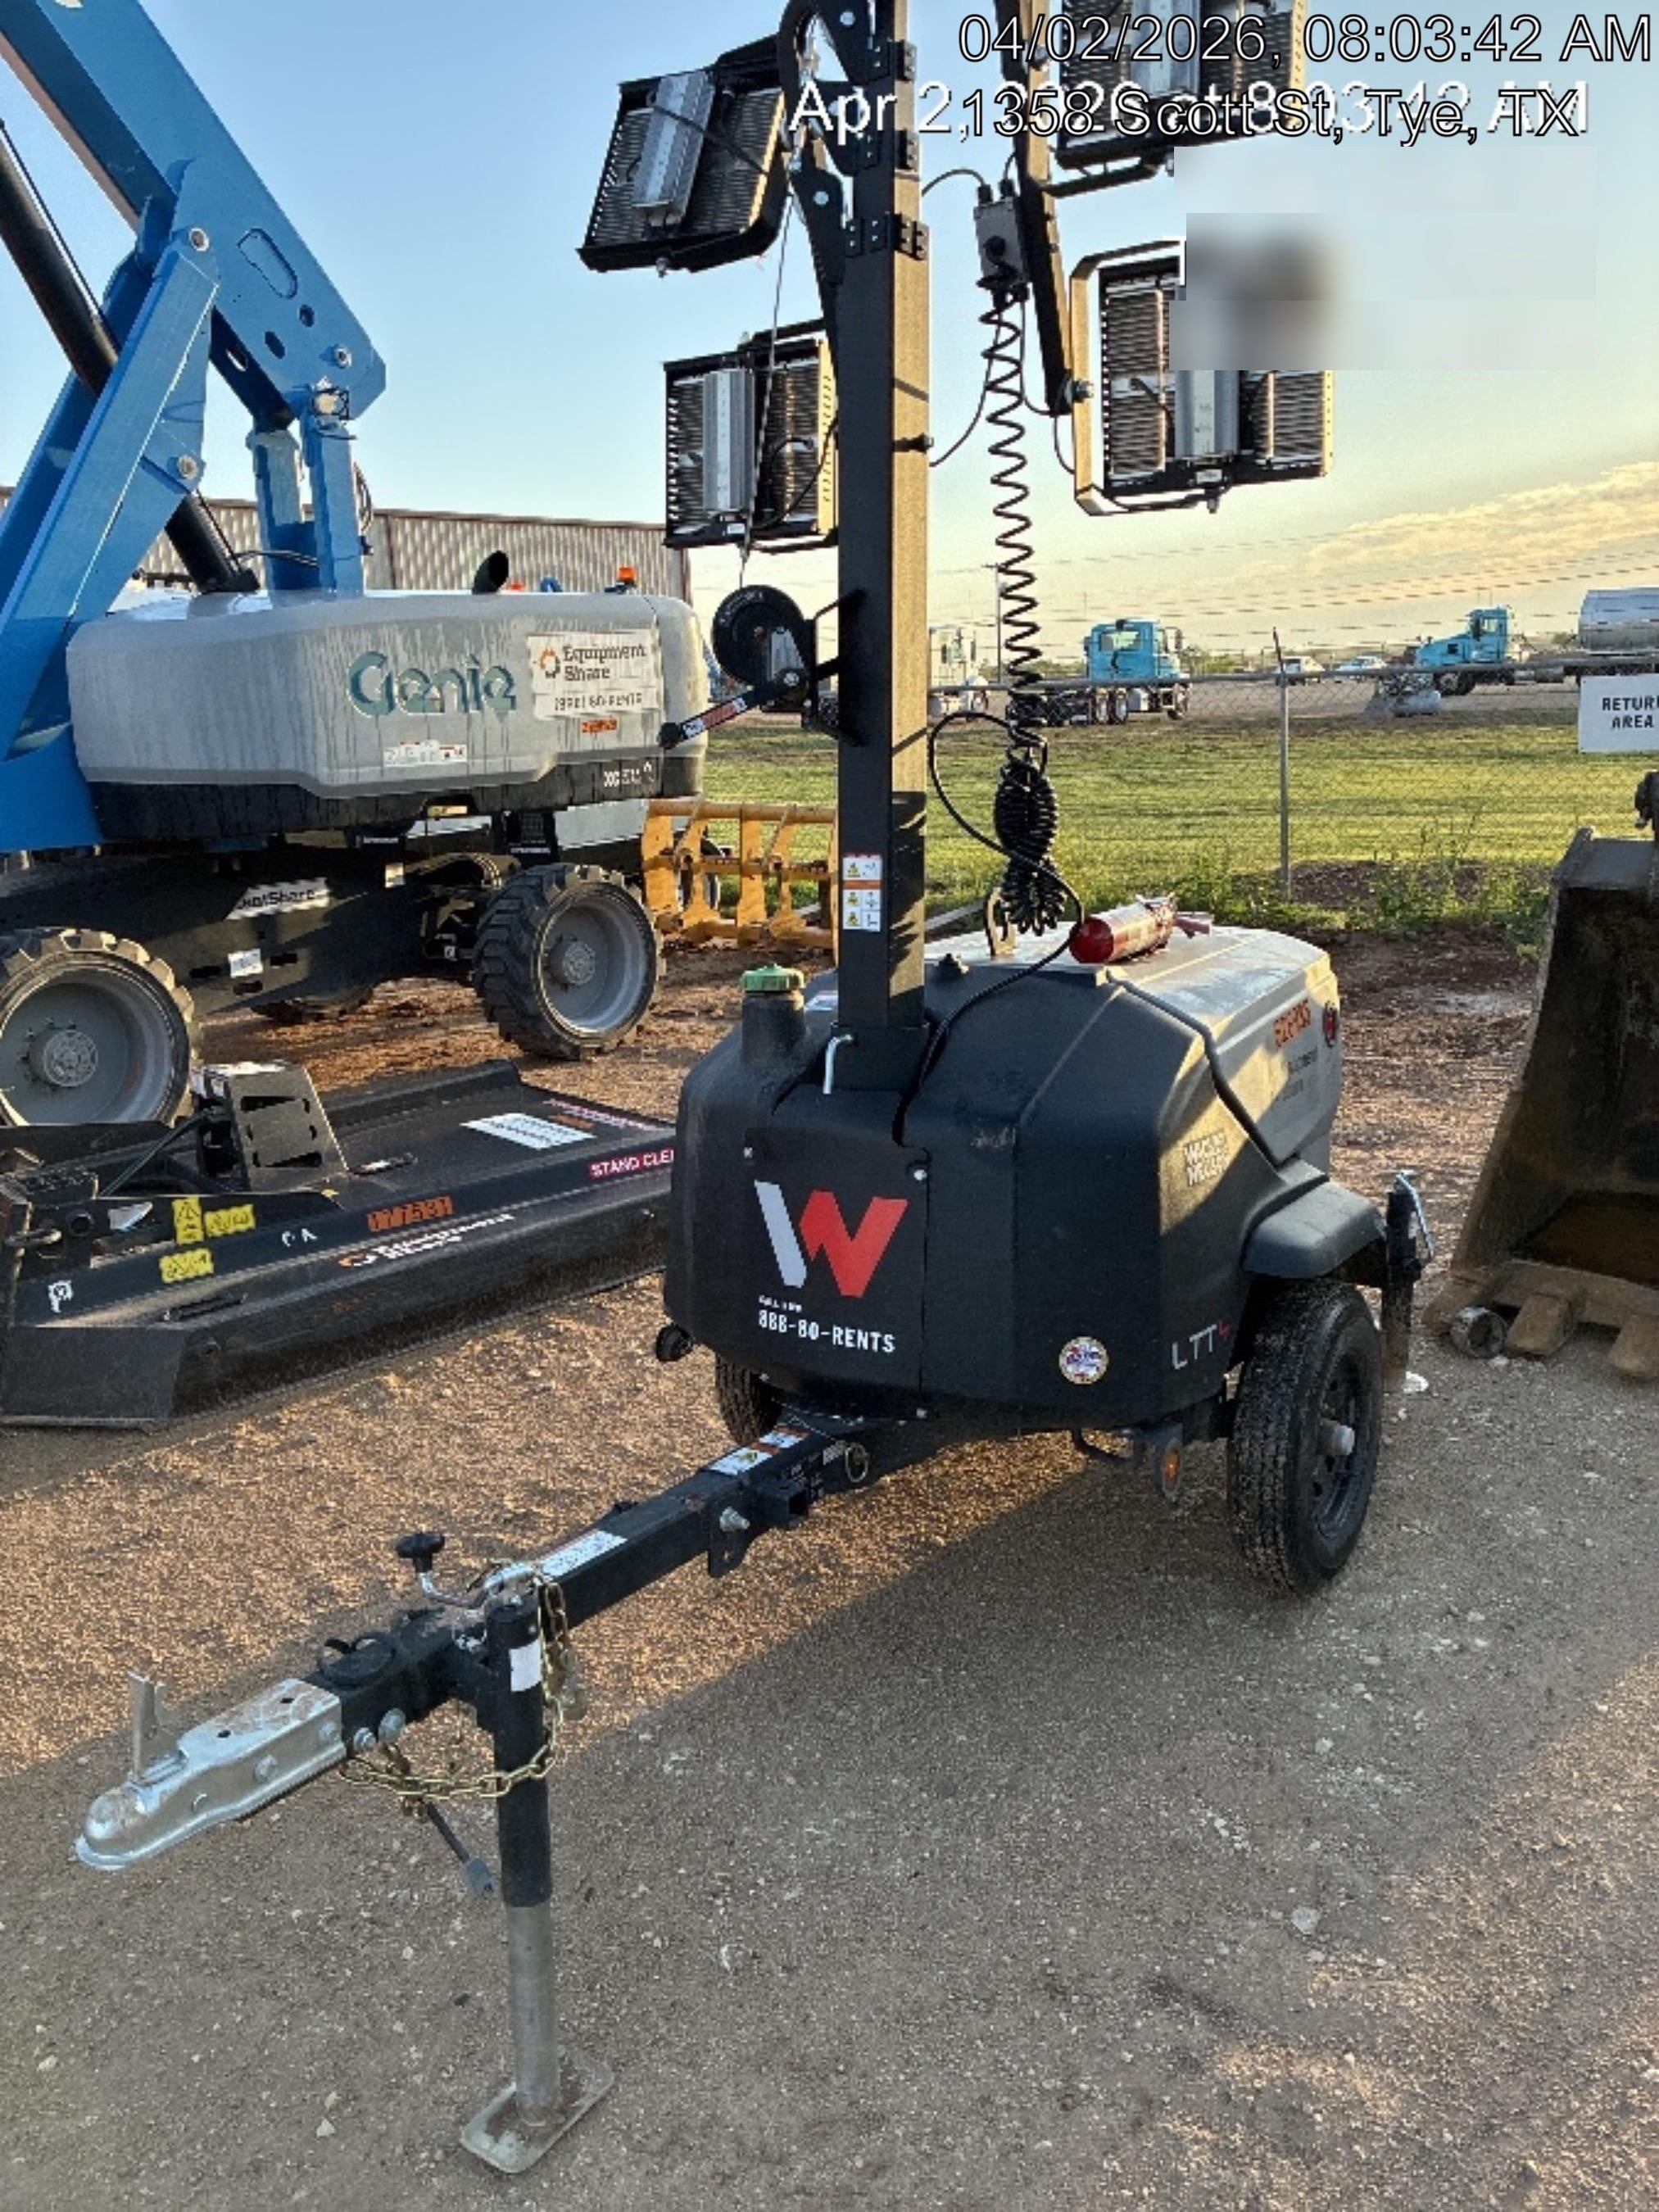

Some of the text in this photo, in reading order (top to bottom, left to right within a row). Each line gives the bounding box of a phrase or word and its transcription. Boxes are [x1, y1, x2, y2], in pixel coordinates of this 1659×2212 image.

[347, 651, 516, 717] Genie
[1611, 715, 1655, 729] AREA
[591, 1156, 639, 1177] STAND
